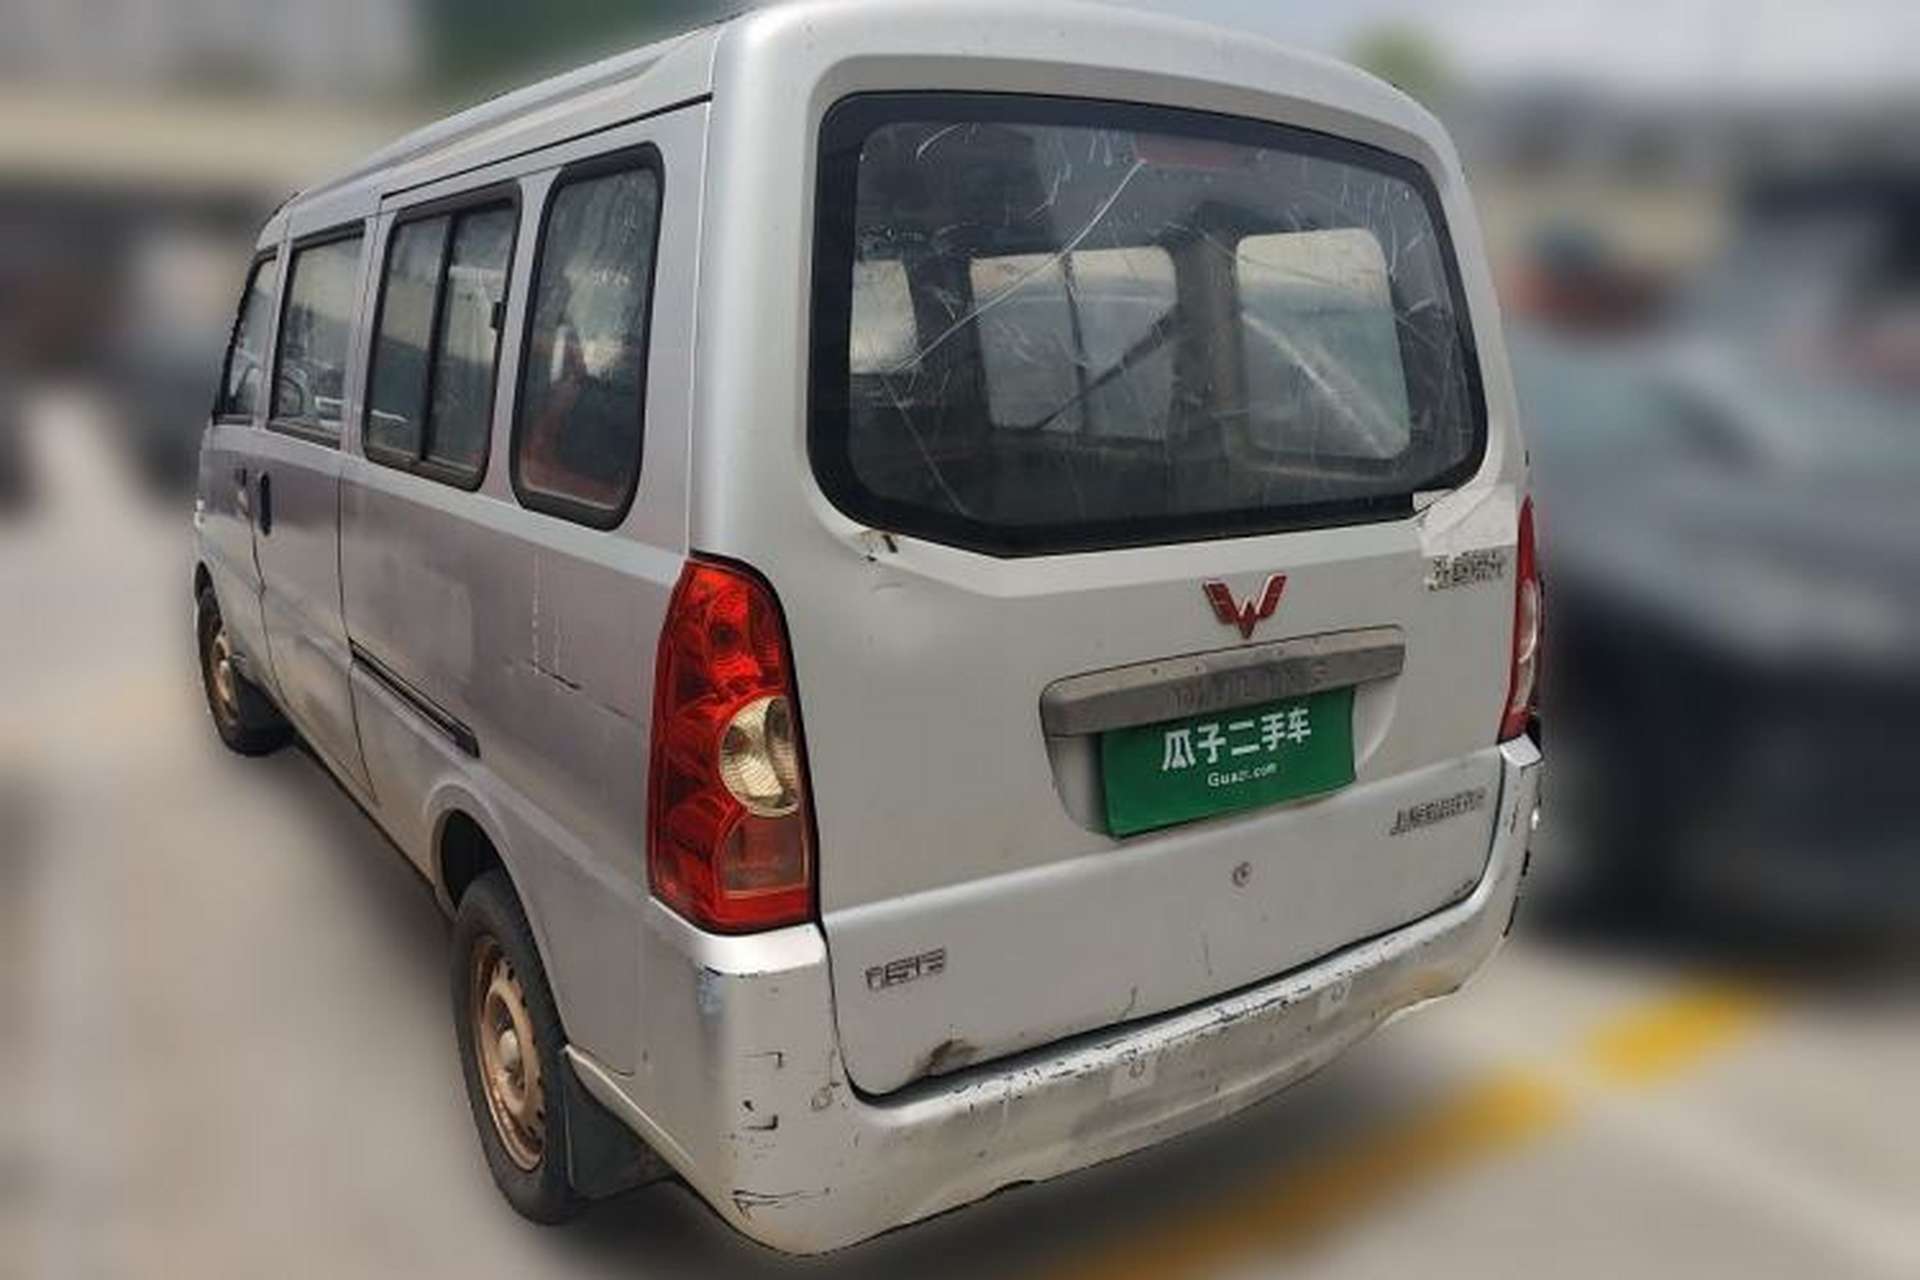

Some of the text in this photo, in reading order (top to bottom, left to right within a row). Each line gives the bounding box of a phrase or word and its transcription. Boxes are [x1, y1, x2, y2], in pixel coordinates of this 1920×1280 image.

[1162, 707, 1312, 771] 瓜子二手车
